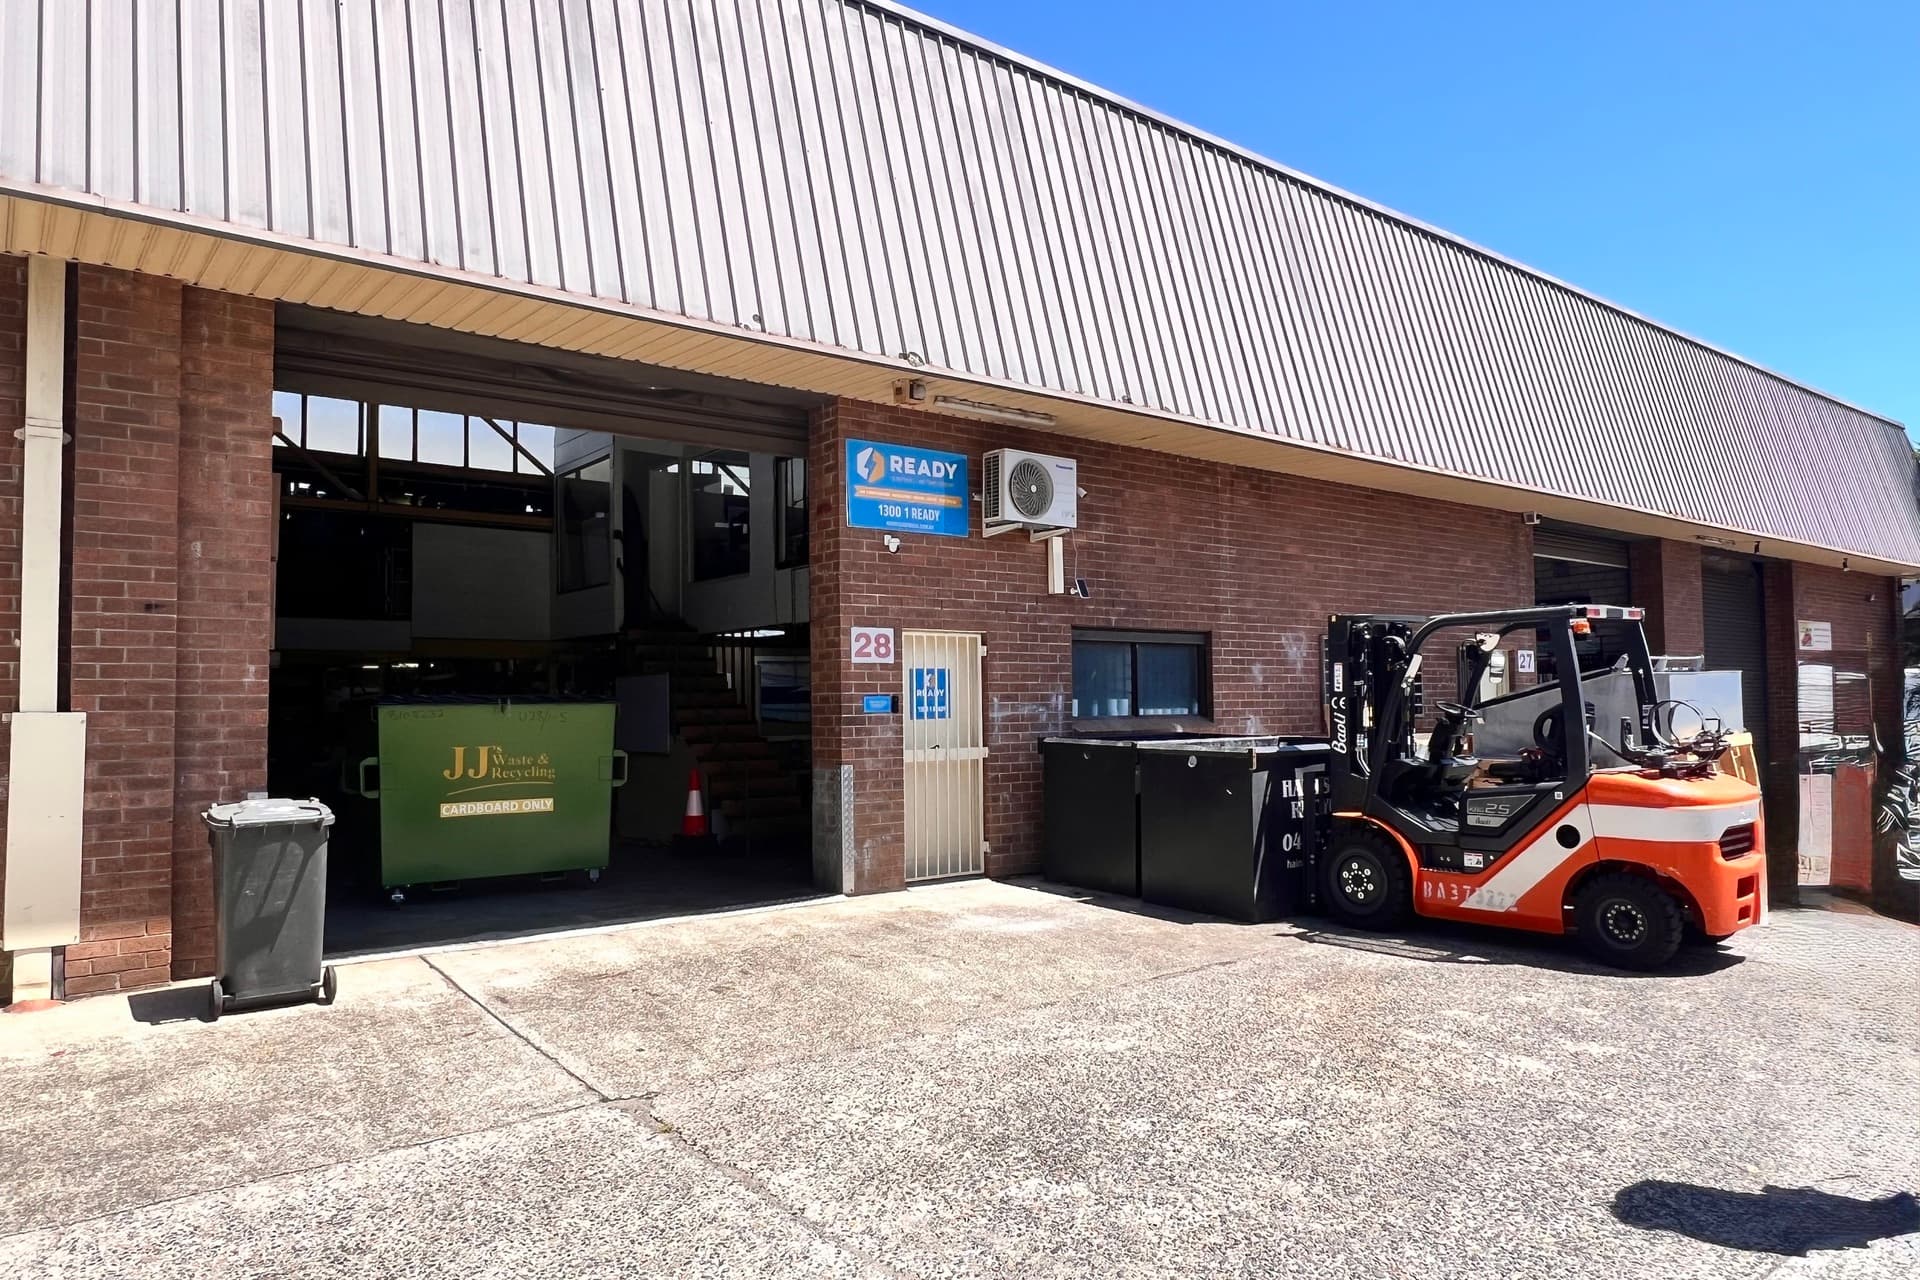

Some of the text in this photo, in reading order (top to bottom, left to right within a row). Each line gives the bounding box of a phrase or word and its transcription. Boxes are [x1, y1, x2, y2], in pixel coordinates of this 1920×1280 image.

[890, 455, 957, 479] READY
[878, 504, 940, 521] 1300 1 READY
[854, 632, 891, 658] 28
[1519, 653, 1533, 669] 27
[493, 753, 534, 766] Waste
[537, 752, 549, 765] &
[492, 765, 556, 780] Recycling
[442, 798, 553, 816] CARDBOARD ONLY
